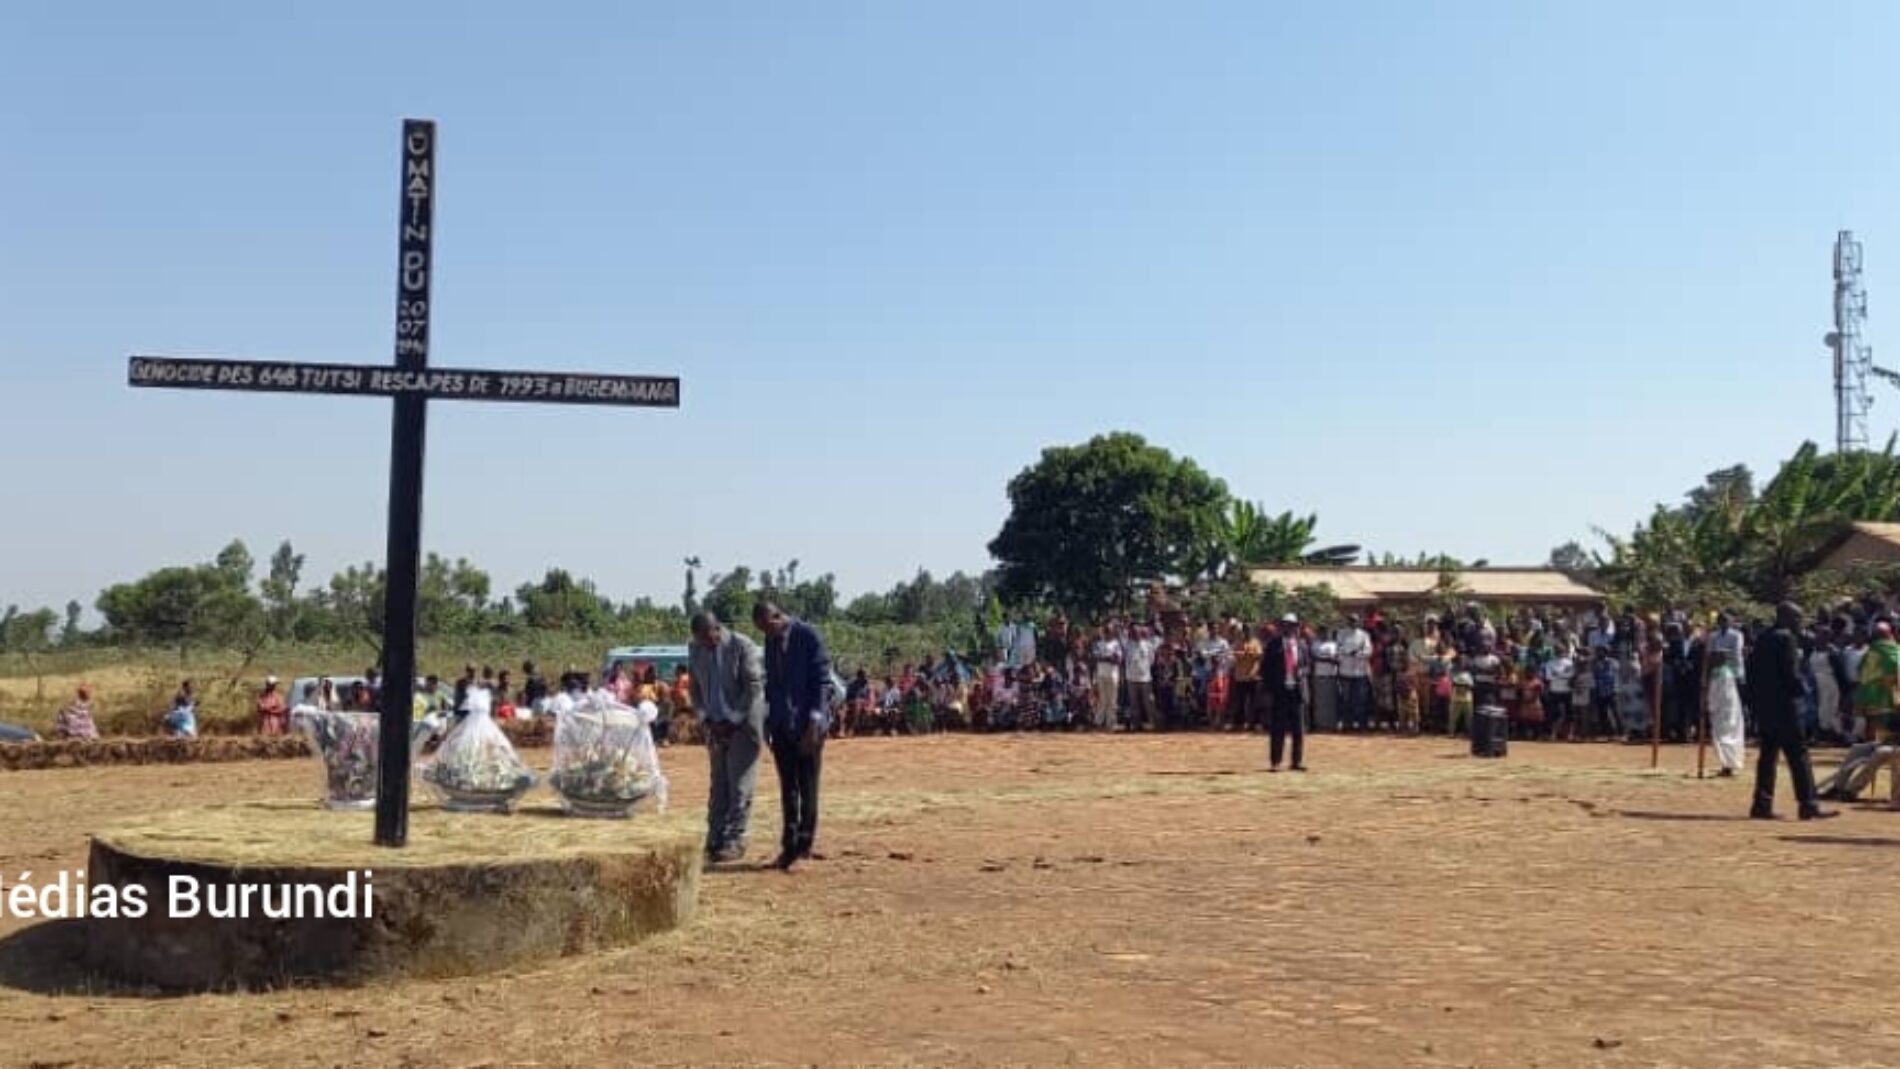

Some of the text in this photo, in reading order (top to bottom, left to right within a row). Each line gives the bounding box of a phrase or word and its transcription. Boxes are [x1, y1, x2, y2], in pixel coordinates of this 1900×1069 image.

[404, 251, 425, 290] DU
[301, 368, 361, 389] TUTSI
[499, 376, 549, 396] 1993
